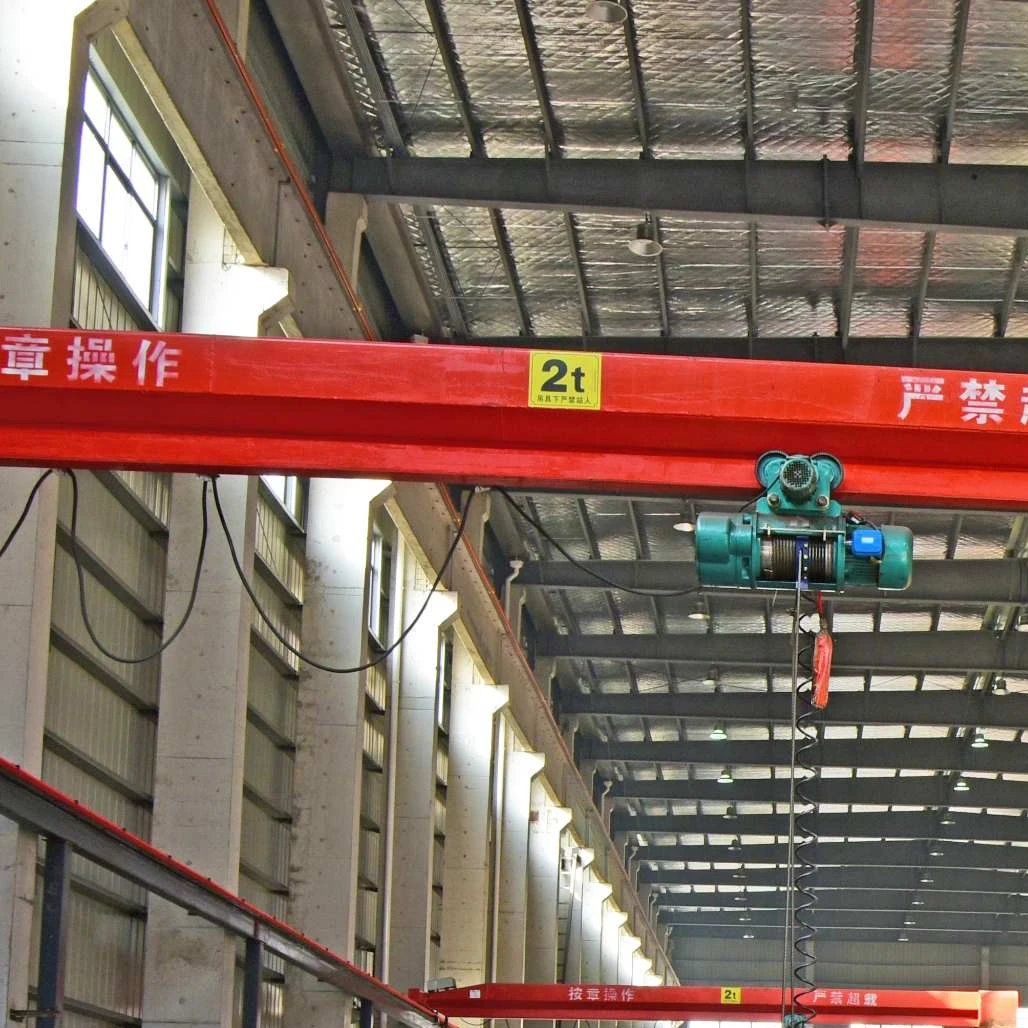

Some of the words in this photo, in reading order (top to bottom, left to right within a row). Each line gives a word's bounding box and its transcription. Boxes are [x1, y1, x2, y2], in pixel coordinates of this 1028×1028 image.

[0, 334, 182, 387] 章操作
[541, 358, 585, 393] 2t
[724, 989, 736, 1000] 2t
[813, 990, 878, 1006] 严禁超载
